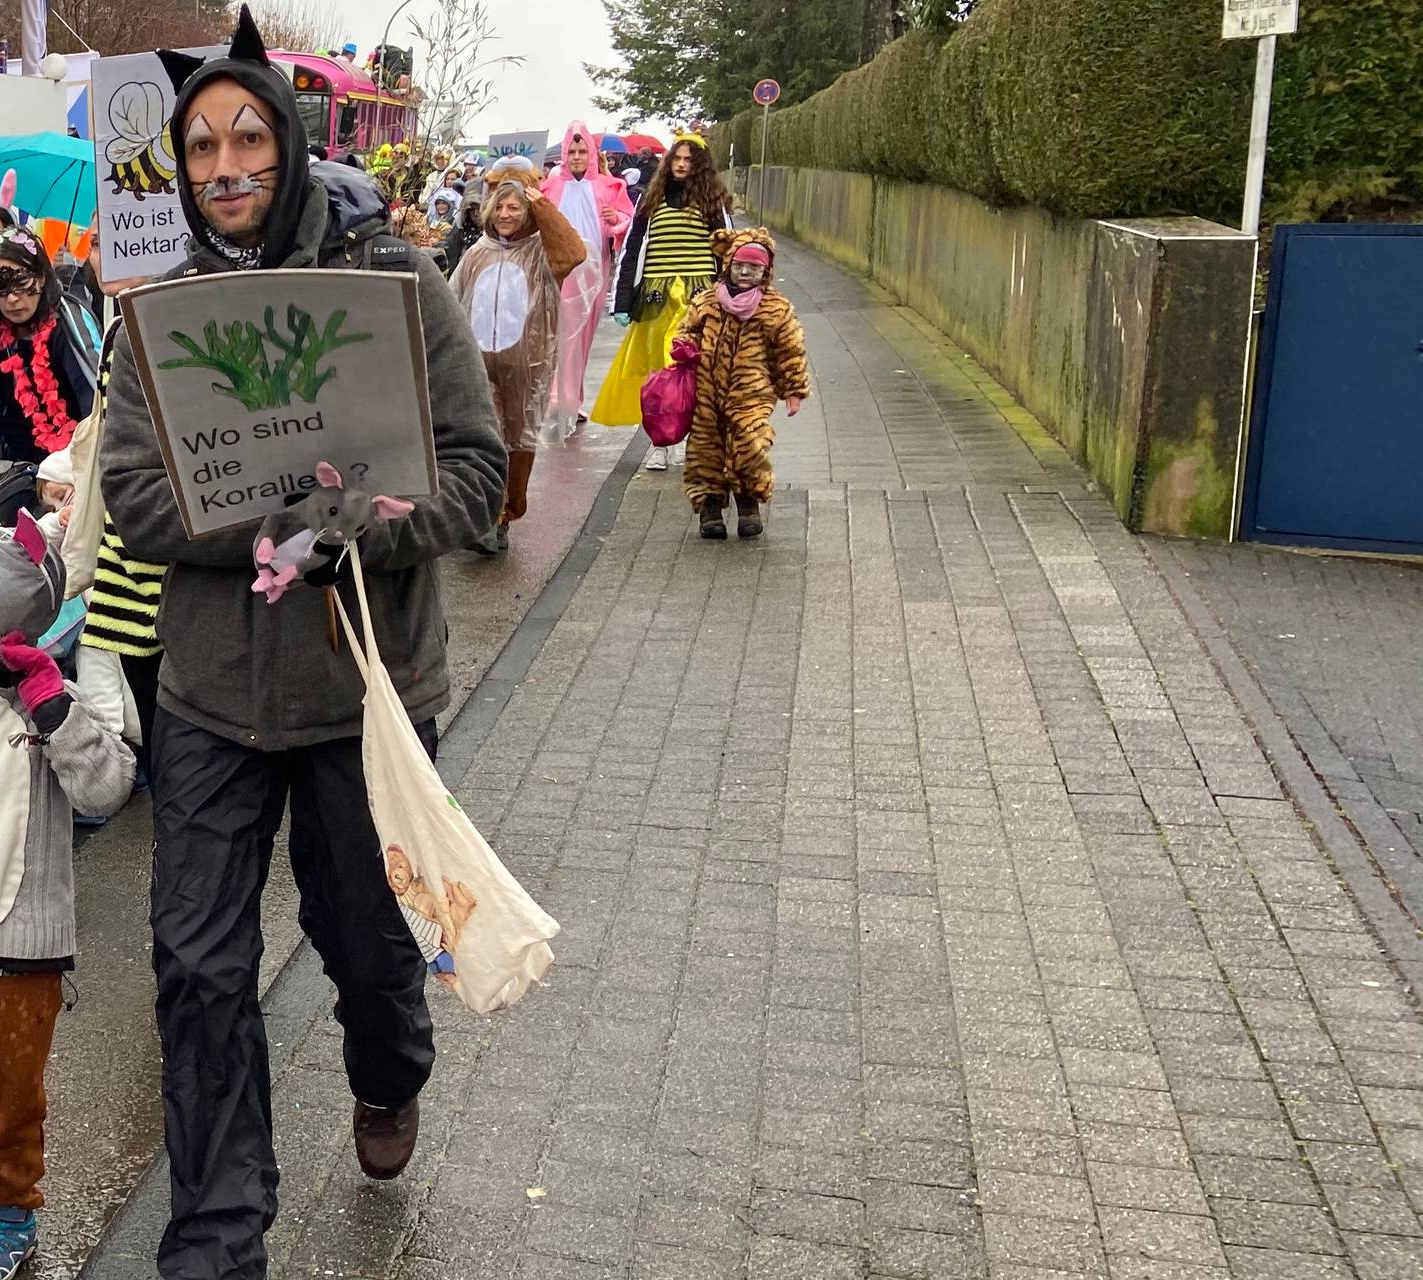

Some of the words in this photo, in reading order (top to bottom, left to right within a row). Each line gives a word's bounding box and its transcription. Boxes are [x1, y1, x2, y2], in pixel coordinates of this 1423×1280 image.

[111, 211, 145, 232] Wo
[151, 207, 175, 227] ist
[113, 232, 191, 259] Nektar?
[182, 427, 241, 456] Wo
[252, 411, 325, 439] sind
[192, 459, 242, 485] die
[199, 462, 370, 514] Koralle?
